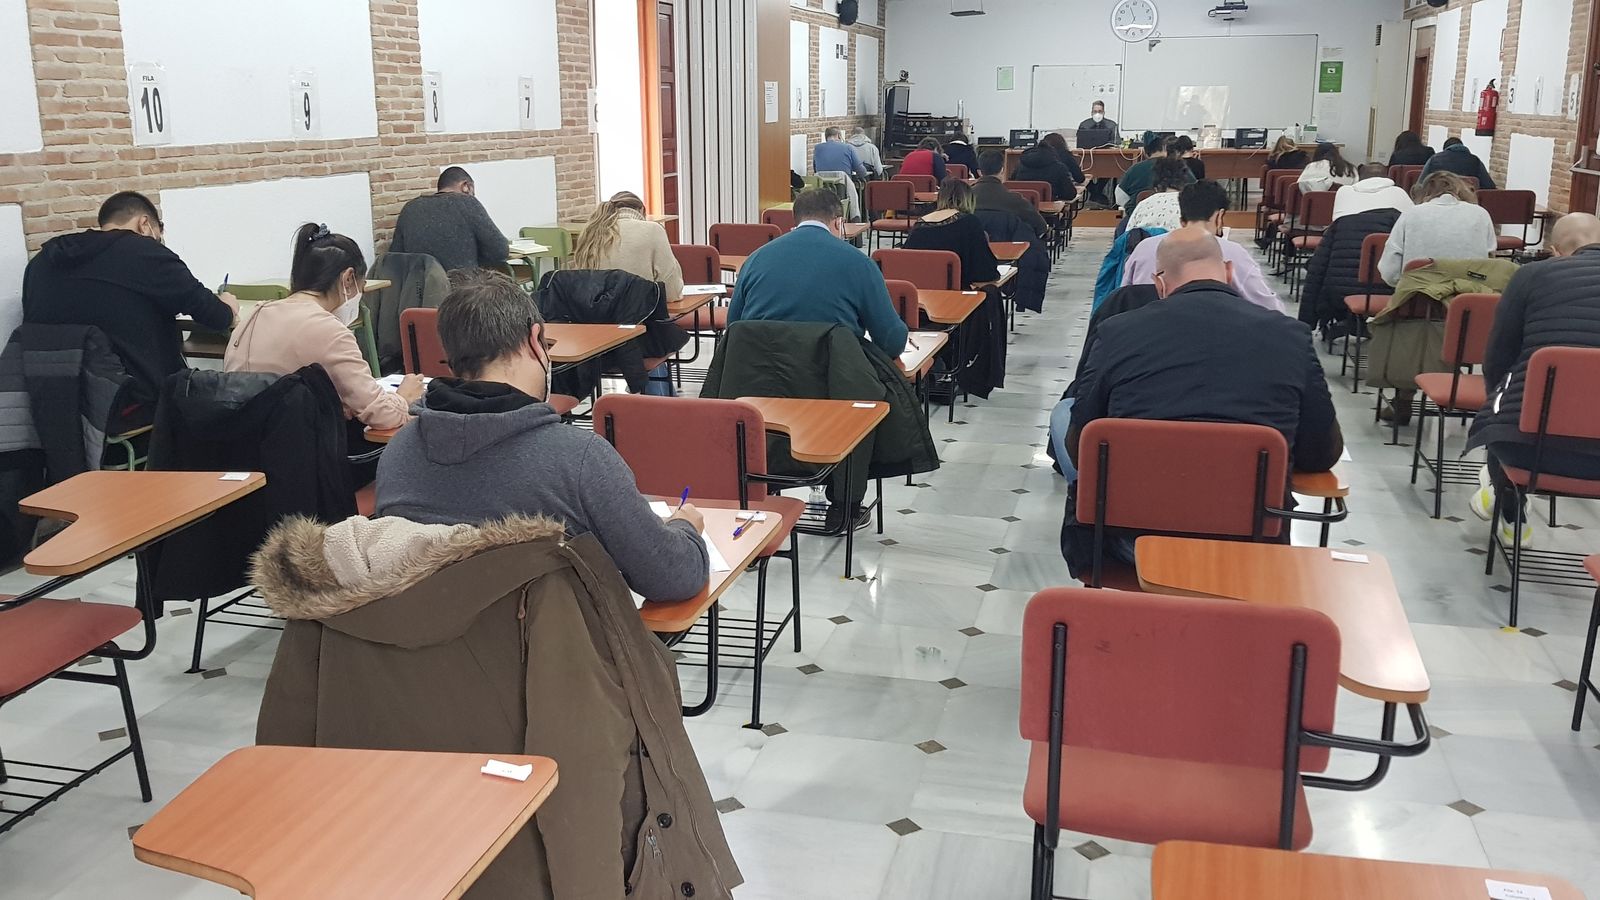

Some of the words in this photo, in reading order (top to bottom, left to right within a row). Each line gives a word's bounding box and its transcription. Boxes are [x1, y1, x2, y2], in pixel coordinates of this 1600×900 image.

[432, 90, 438, 123] 8
[525, 97, 530, 119] 7
[1508, 87, 1514, 104] 3
[1570, 92, 1575, 111] 5
[141, 87, 163, 133] 10
[303, 92, 311, 131] 9
